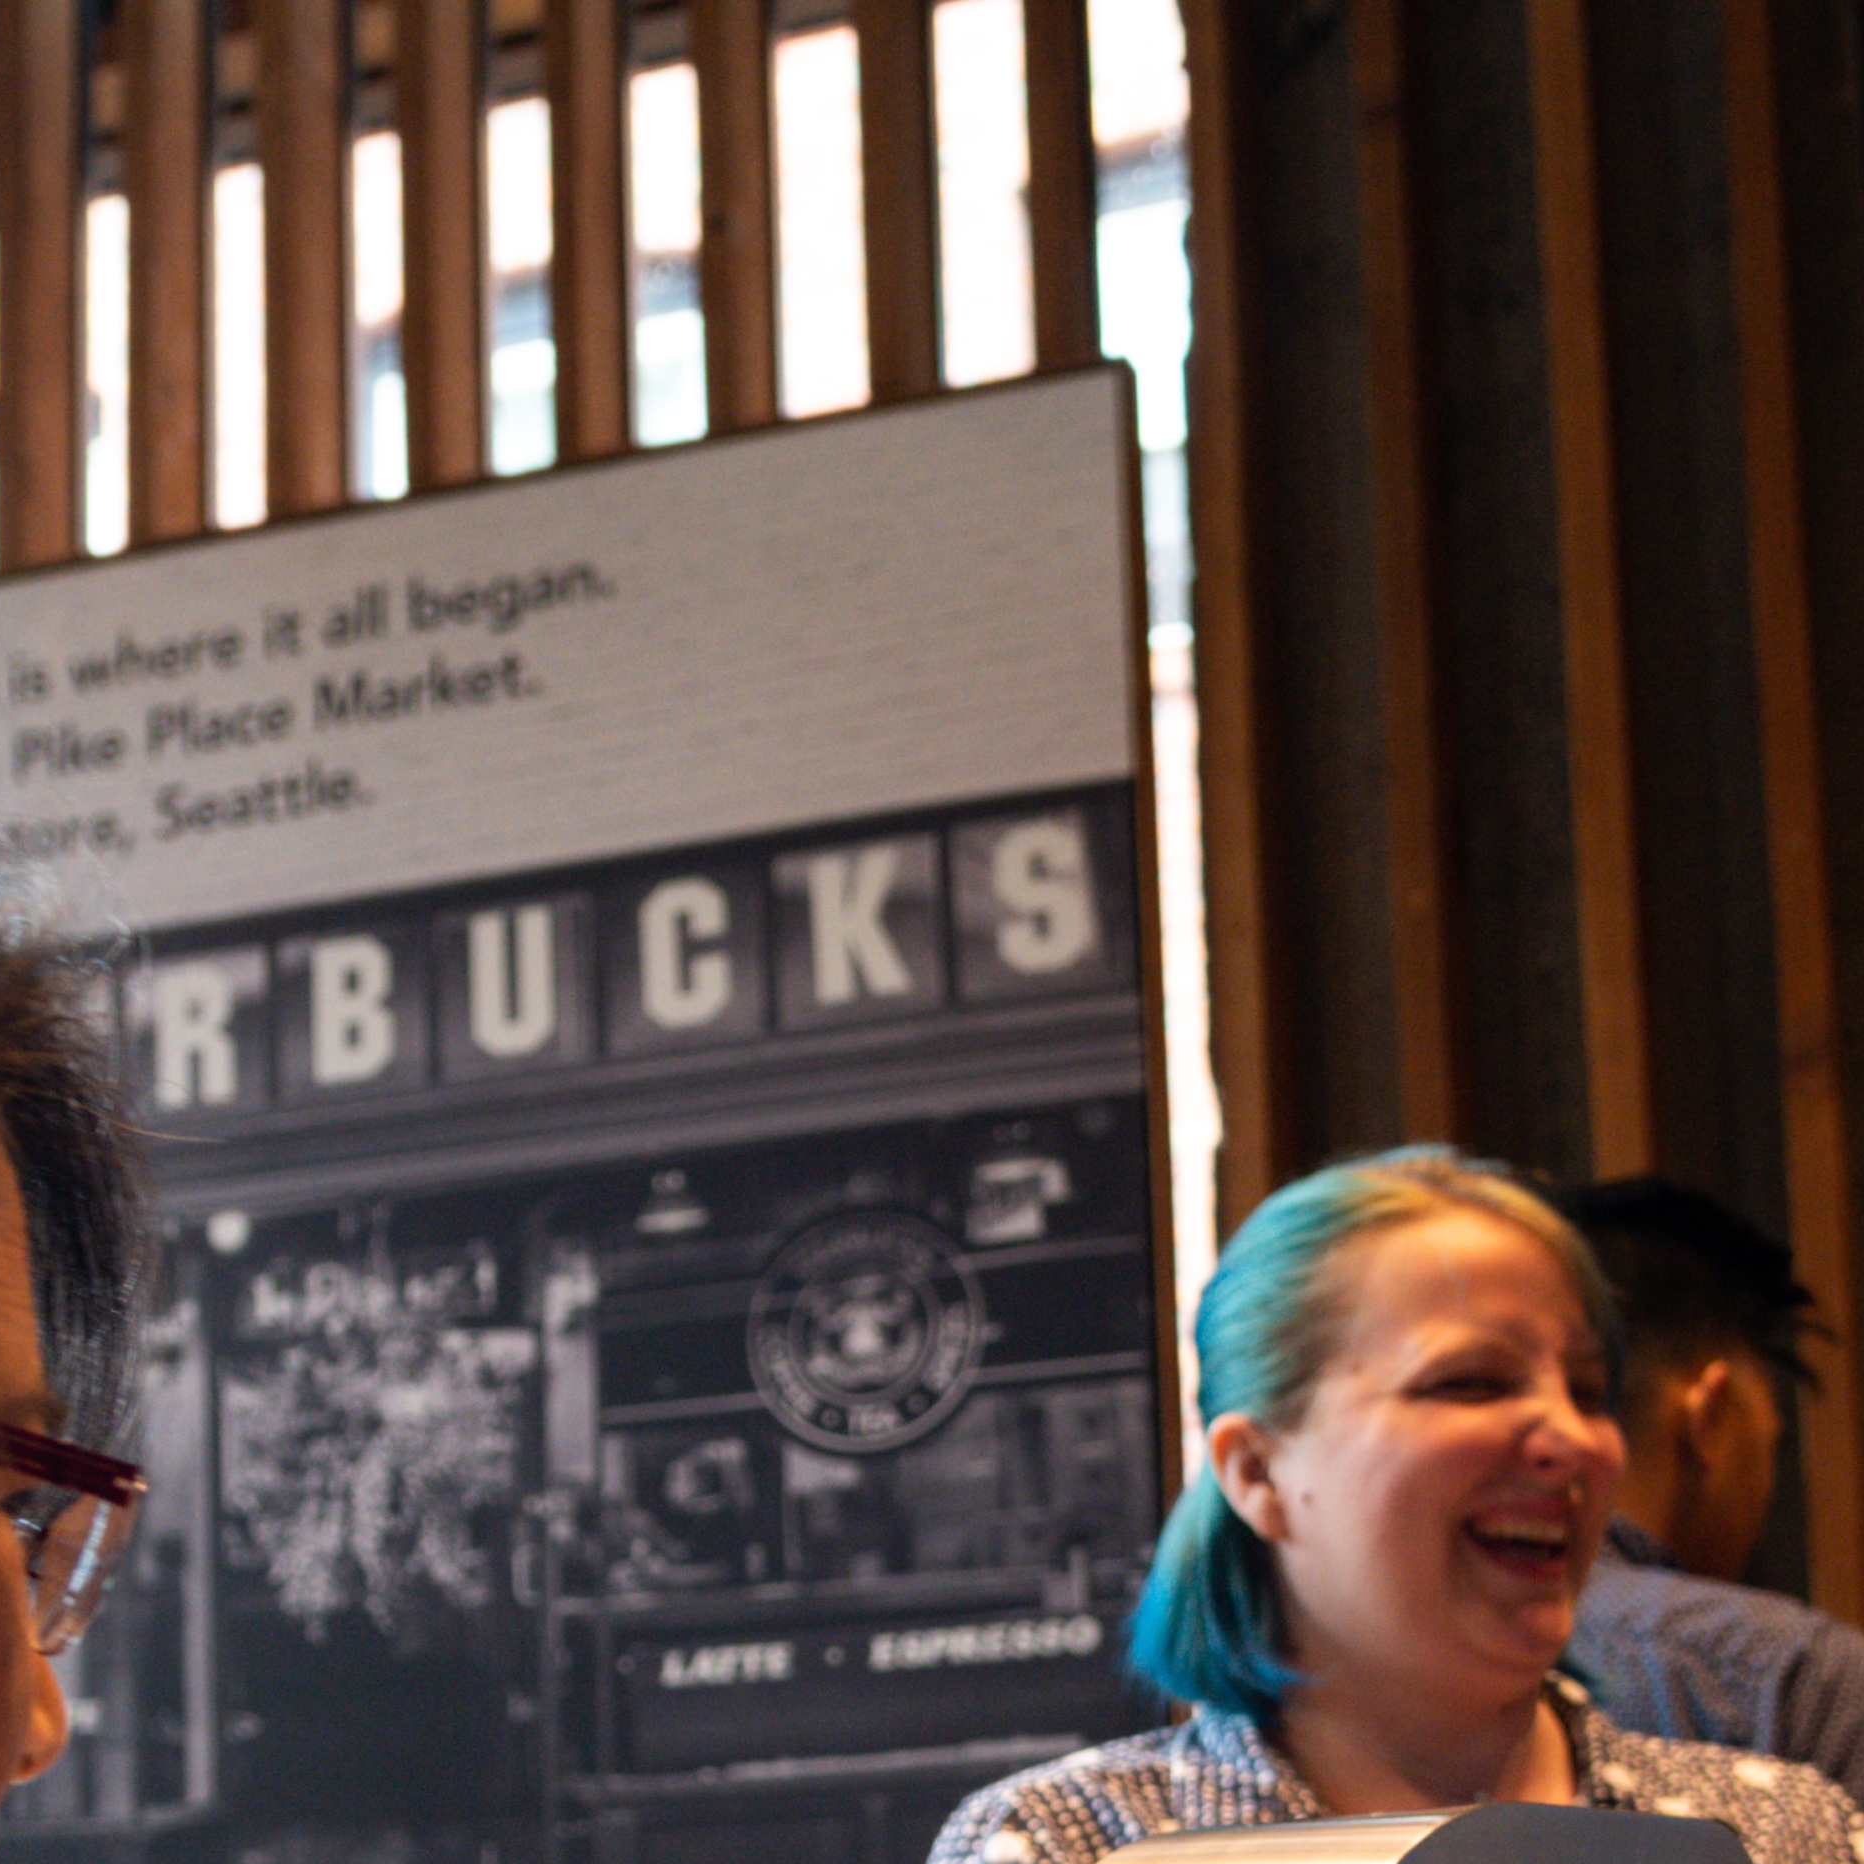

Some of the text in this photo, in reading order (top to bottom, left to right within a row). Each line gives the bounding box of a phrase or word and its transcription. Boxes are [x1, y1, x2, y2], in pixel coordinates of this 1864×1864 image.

[7, 650, 48, 701] is
[68, 628, 243, 692] where
[263, 605, 303, 660] it
[320, 583, 388, 649] all
[406, 562, 619, 635] began.
[11, 719, 128, 785] Pike
[146, 700, 297, 760] Place
[313, 650, 543, 732] Market.
[154, 757, 375, 842] Seattle.
[151, 814, 1100, 1112] RBUCKS
[660, 1613, 1104, 1688] LATTE ESPRESSO
